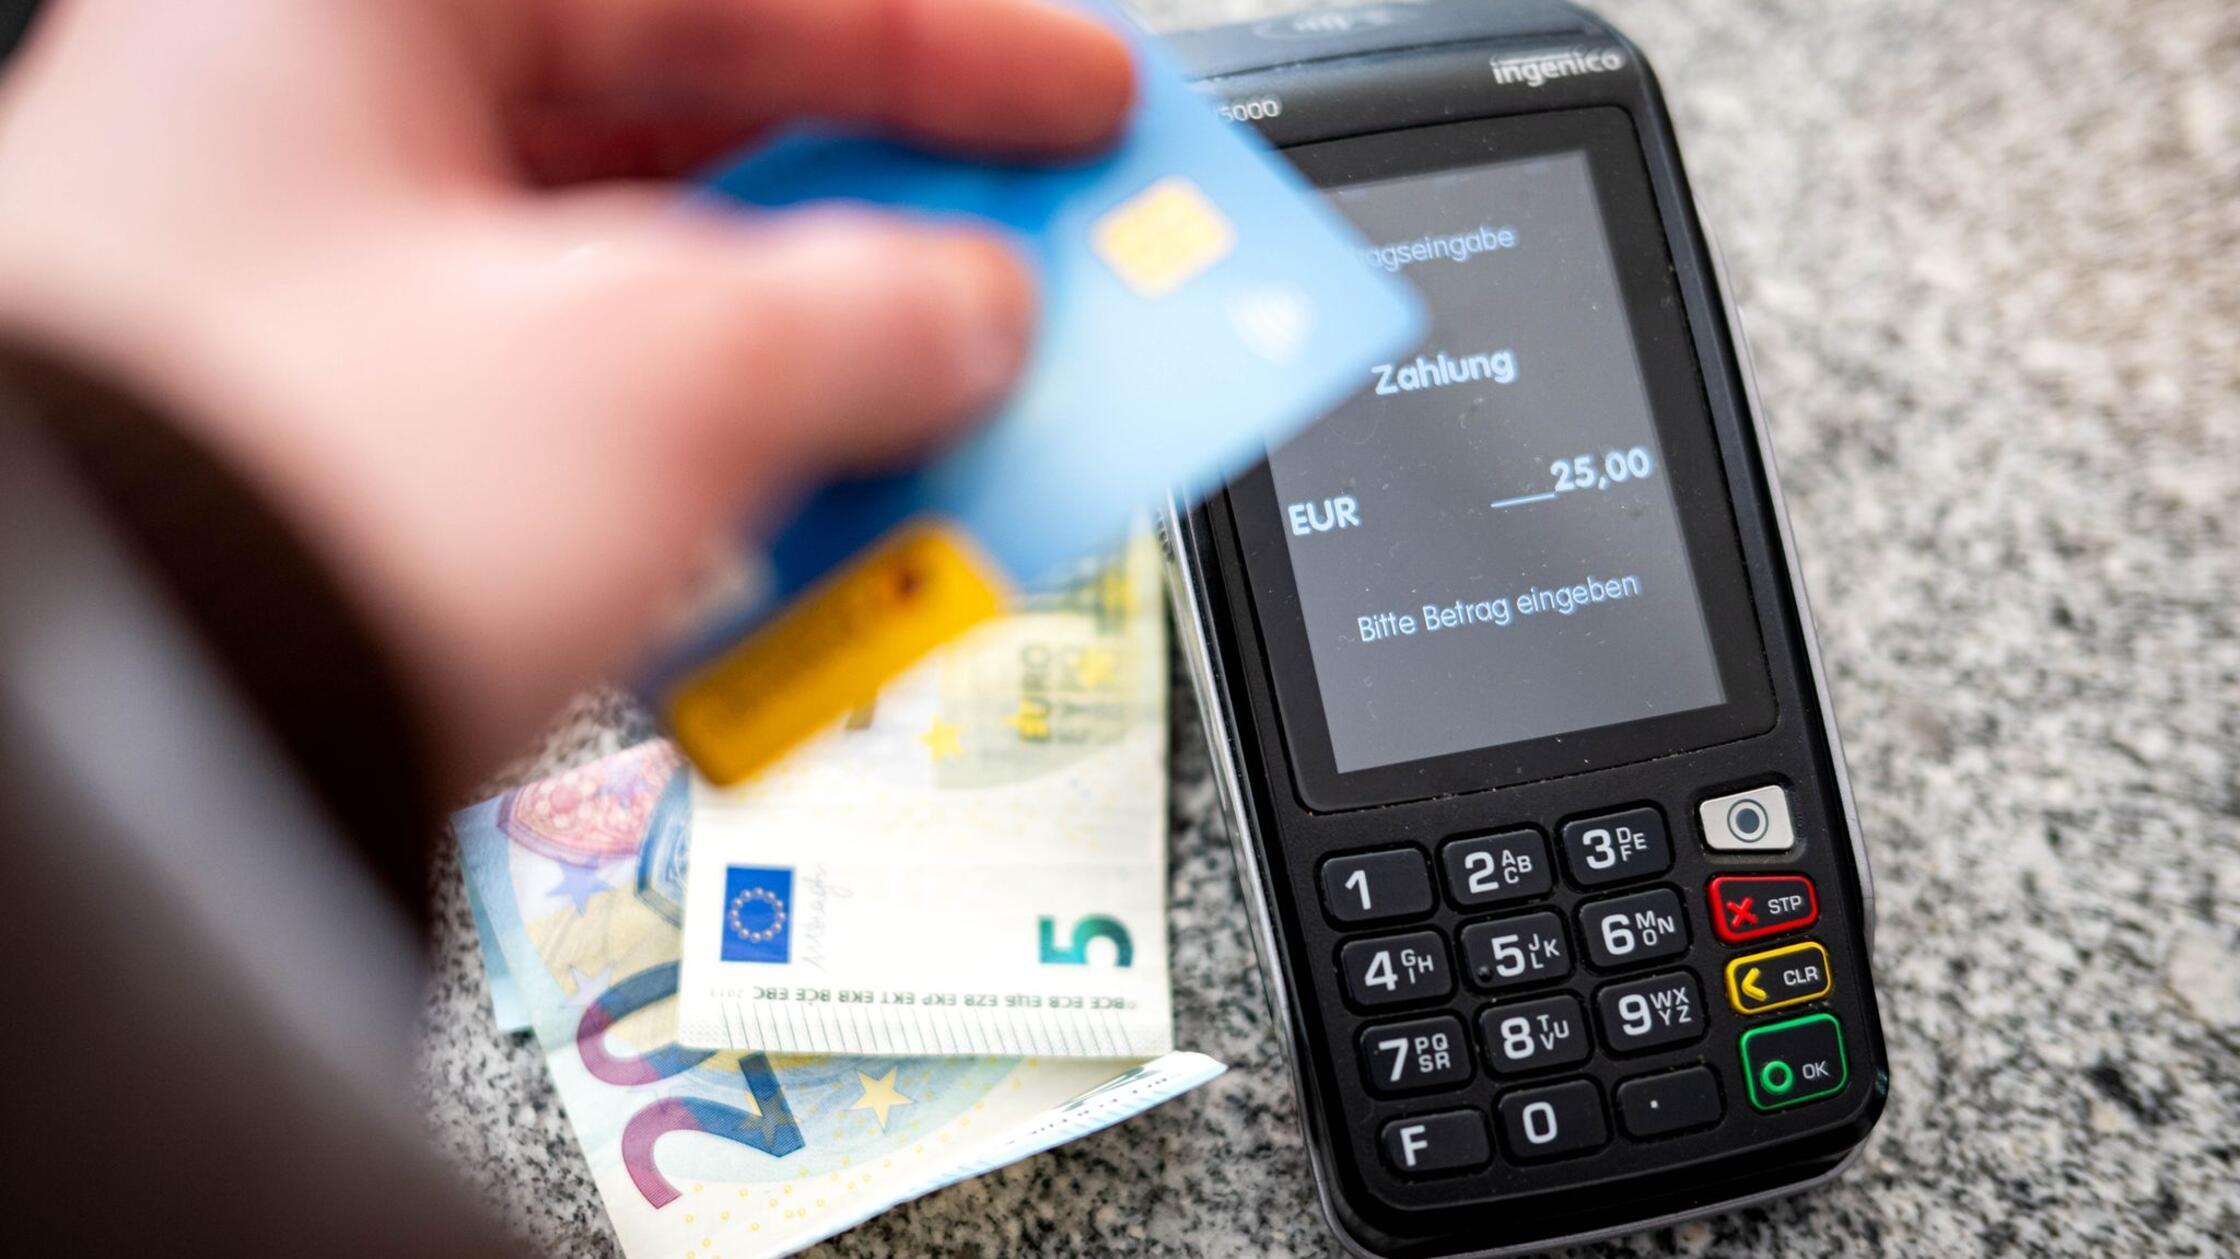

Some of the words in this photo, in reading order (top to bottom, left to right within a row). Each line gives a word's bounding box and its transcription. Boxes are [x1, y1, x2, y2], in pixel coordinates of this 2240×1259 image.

[1489, 47, 1624, 87] ingenico
[1367, 226, 1516, 272] agseingabe
[1372, 350, 1518, 395] Zahlung
[1287, 496, 1361, 536] EUR
[1356, 610, 1417, 643] Bitte
[1422, 596, 1511, 631] Betrag
[1516, 574, 1640, 615] eingeben
[1582, 828, 1617, 870] 3
[1345, 869, 1372, 910] 1
[1464, 851, 1500, 894] 2
[1767, 894, 1802, 915] STP
[1037, 913, 1135, 968] 5
[1491, 933, 1526, 977] 5
[1601, 913, 1635, 956] 6
[1364, 950, 1399, 991] 4
[1783, 965, 1819, 987] CLR
[752, 986, 789, 1000] EBC
[838, 989, 873, 1004] EKB
[880, 989, 916, 1005] EKT
[922, 992, 957, 1006] EKP
[963, 993, 998, 1007] EZB
[1048, 995, 1084, 1009] ECB
[1618, 994, 1651, 1036] 9
[1500, 1016, 1535, 1060] 8
[1378, 1037, 1409, 1082] 7
[1802, 1060, 1829, 1080] OK
[1522, 1101, 1558, 1144] 0
[1400, 1125, 1428, 1167] F
